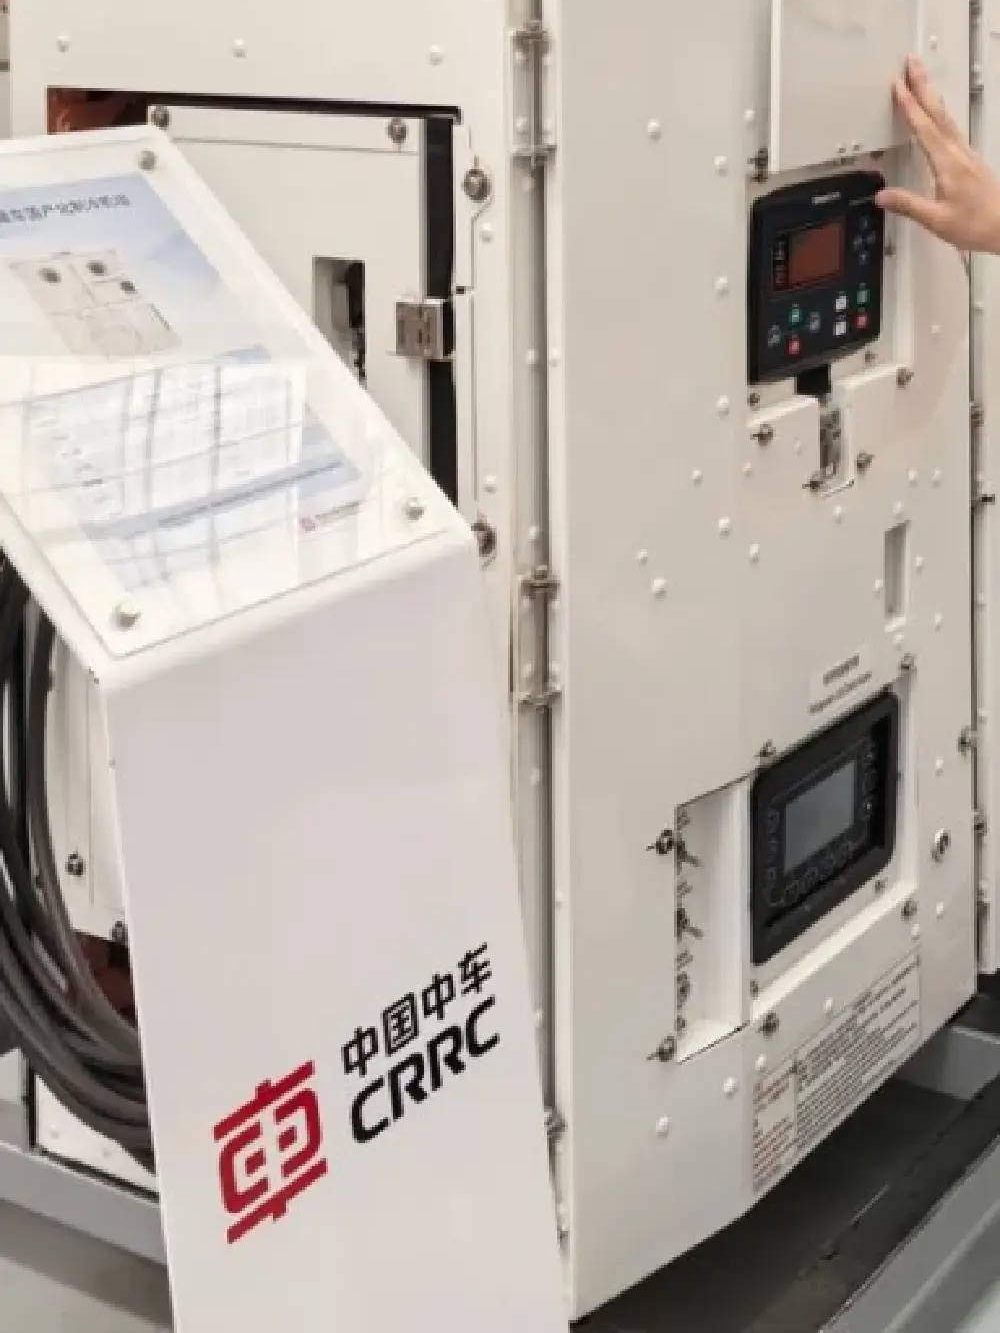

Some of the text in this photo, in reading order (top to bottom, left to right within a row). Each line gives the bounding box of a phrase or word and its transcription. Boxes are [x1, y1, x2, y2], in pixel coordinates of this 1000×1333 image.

[341, 941, 493, 1078] 中国中车
[349, 994, 500, 1144] CRRC
